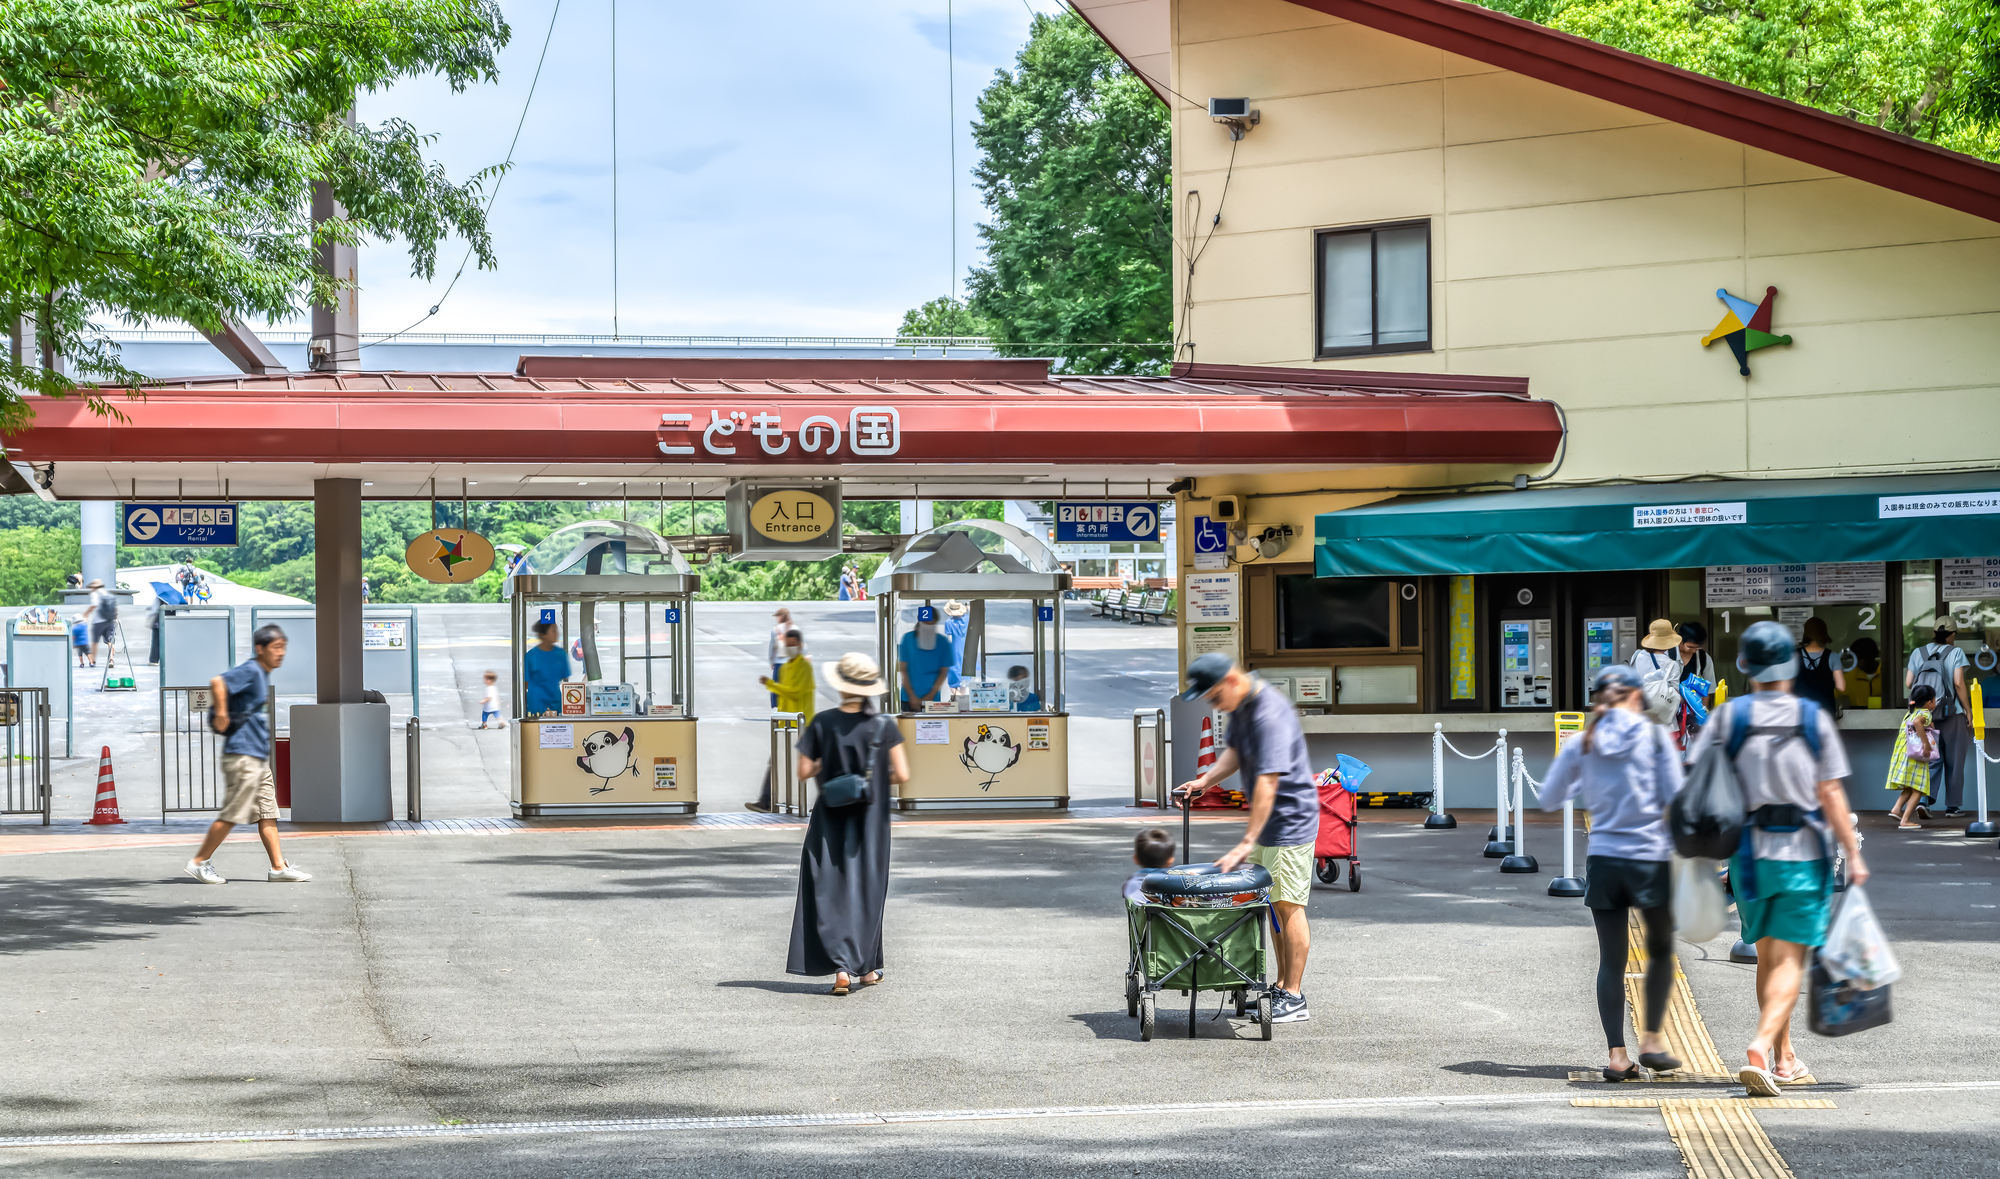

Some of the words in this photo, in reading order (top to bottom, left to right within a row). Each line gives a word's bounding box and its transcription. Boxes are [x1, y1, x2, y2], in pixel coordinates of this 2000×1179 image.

[658, 406, 901, 456] こどもの国
[771, 501, 814, 520] 入口
[1637, 514, 1743, 525] 有料入園20人以上で団体の扱いです
[178, 527, 216, 536] レンタル
[766, 522, 821, 532] Entrance
[1076, 524, 1108, 533] 案内所
[544, 612, 552, 620] 4
[669, 612, 676, 620] 3
[922, 610, 929, 618] 2
[1043, 610, 1047, 618] 1
[1858, 607, 1877, 630] 2
[1953, 605, 1974, 629] 3
[1721, 610, 1730, 633] 1
